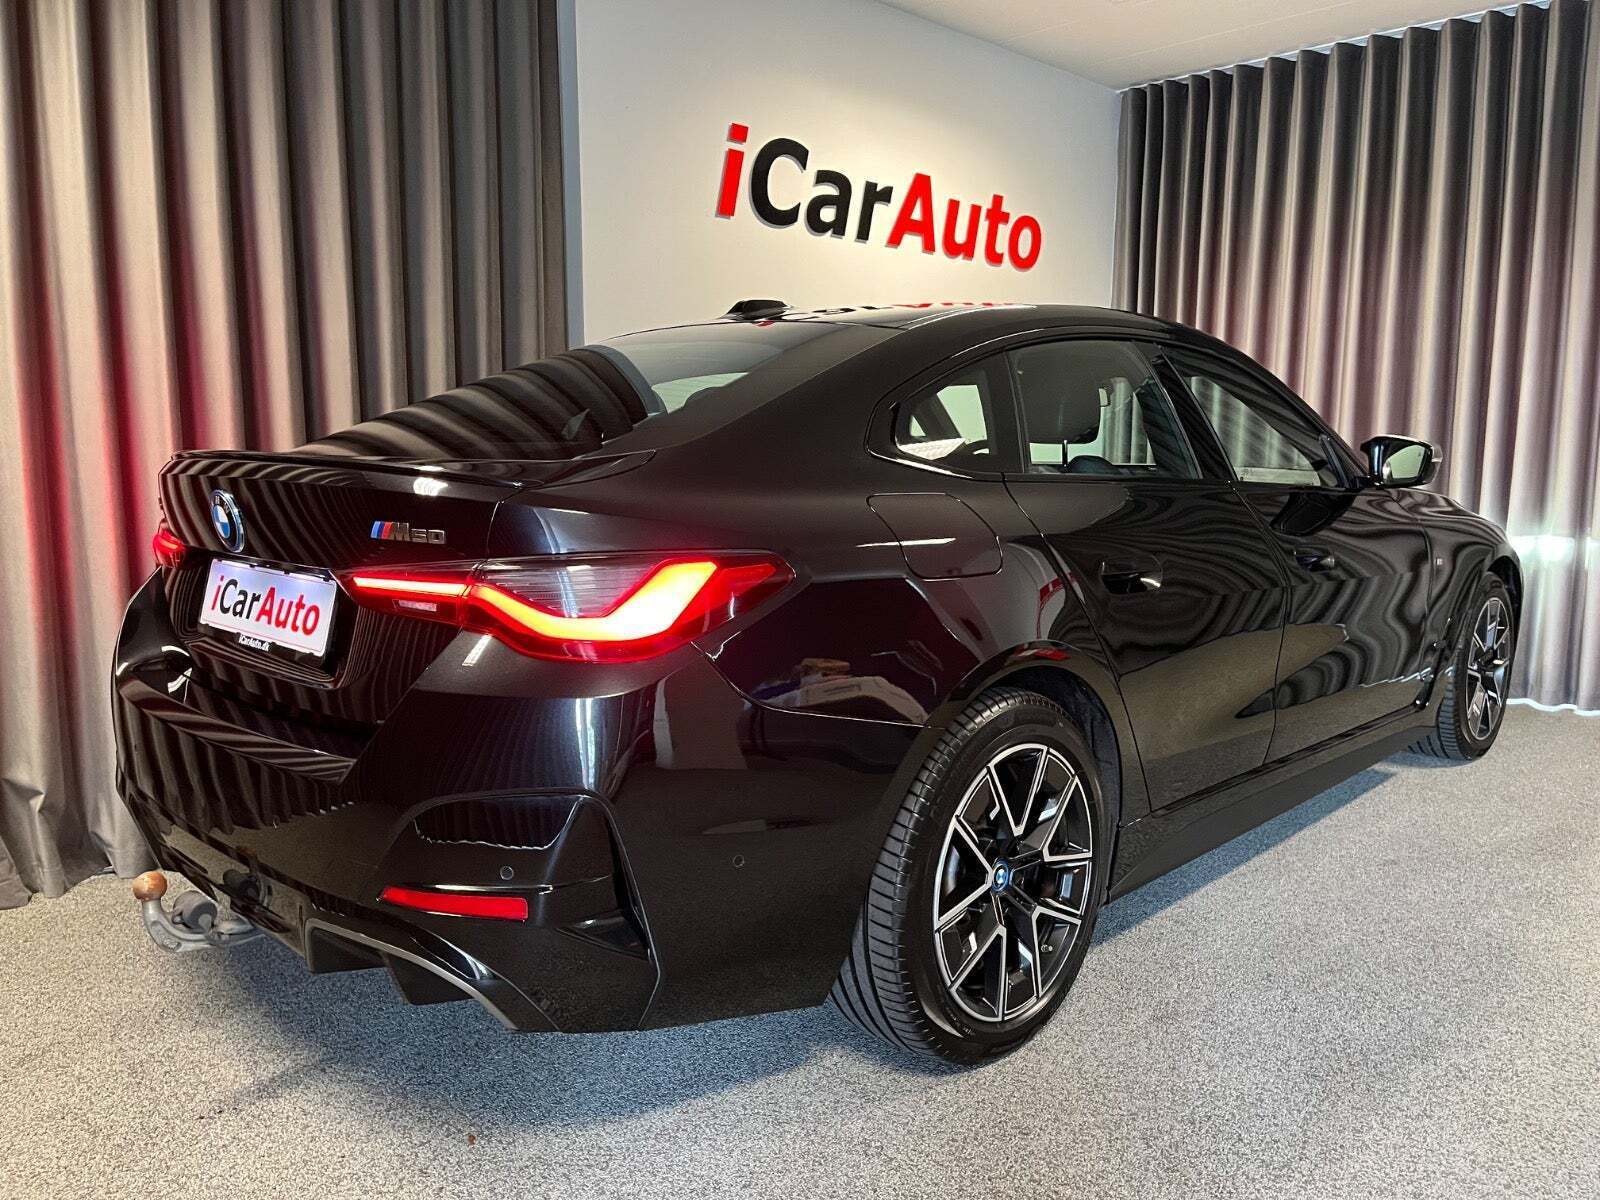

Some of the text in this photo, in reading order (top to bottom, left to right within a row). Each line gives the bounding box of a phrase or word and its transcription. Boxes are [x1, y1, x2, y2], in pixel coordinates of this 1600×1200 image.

[714, 122, 1042, 272] iCarAuto
[390, 520, 446, 545] M50
[210, 574, 321, 637] iCarAuto
